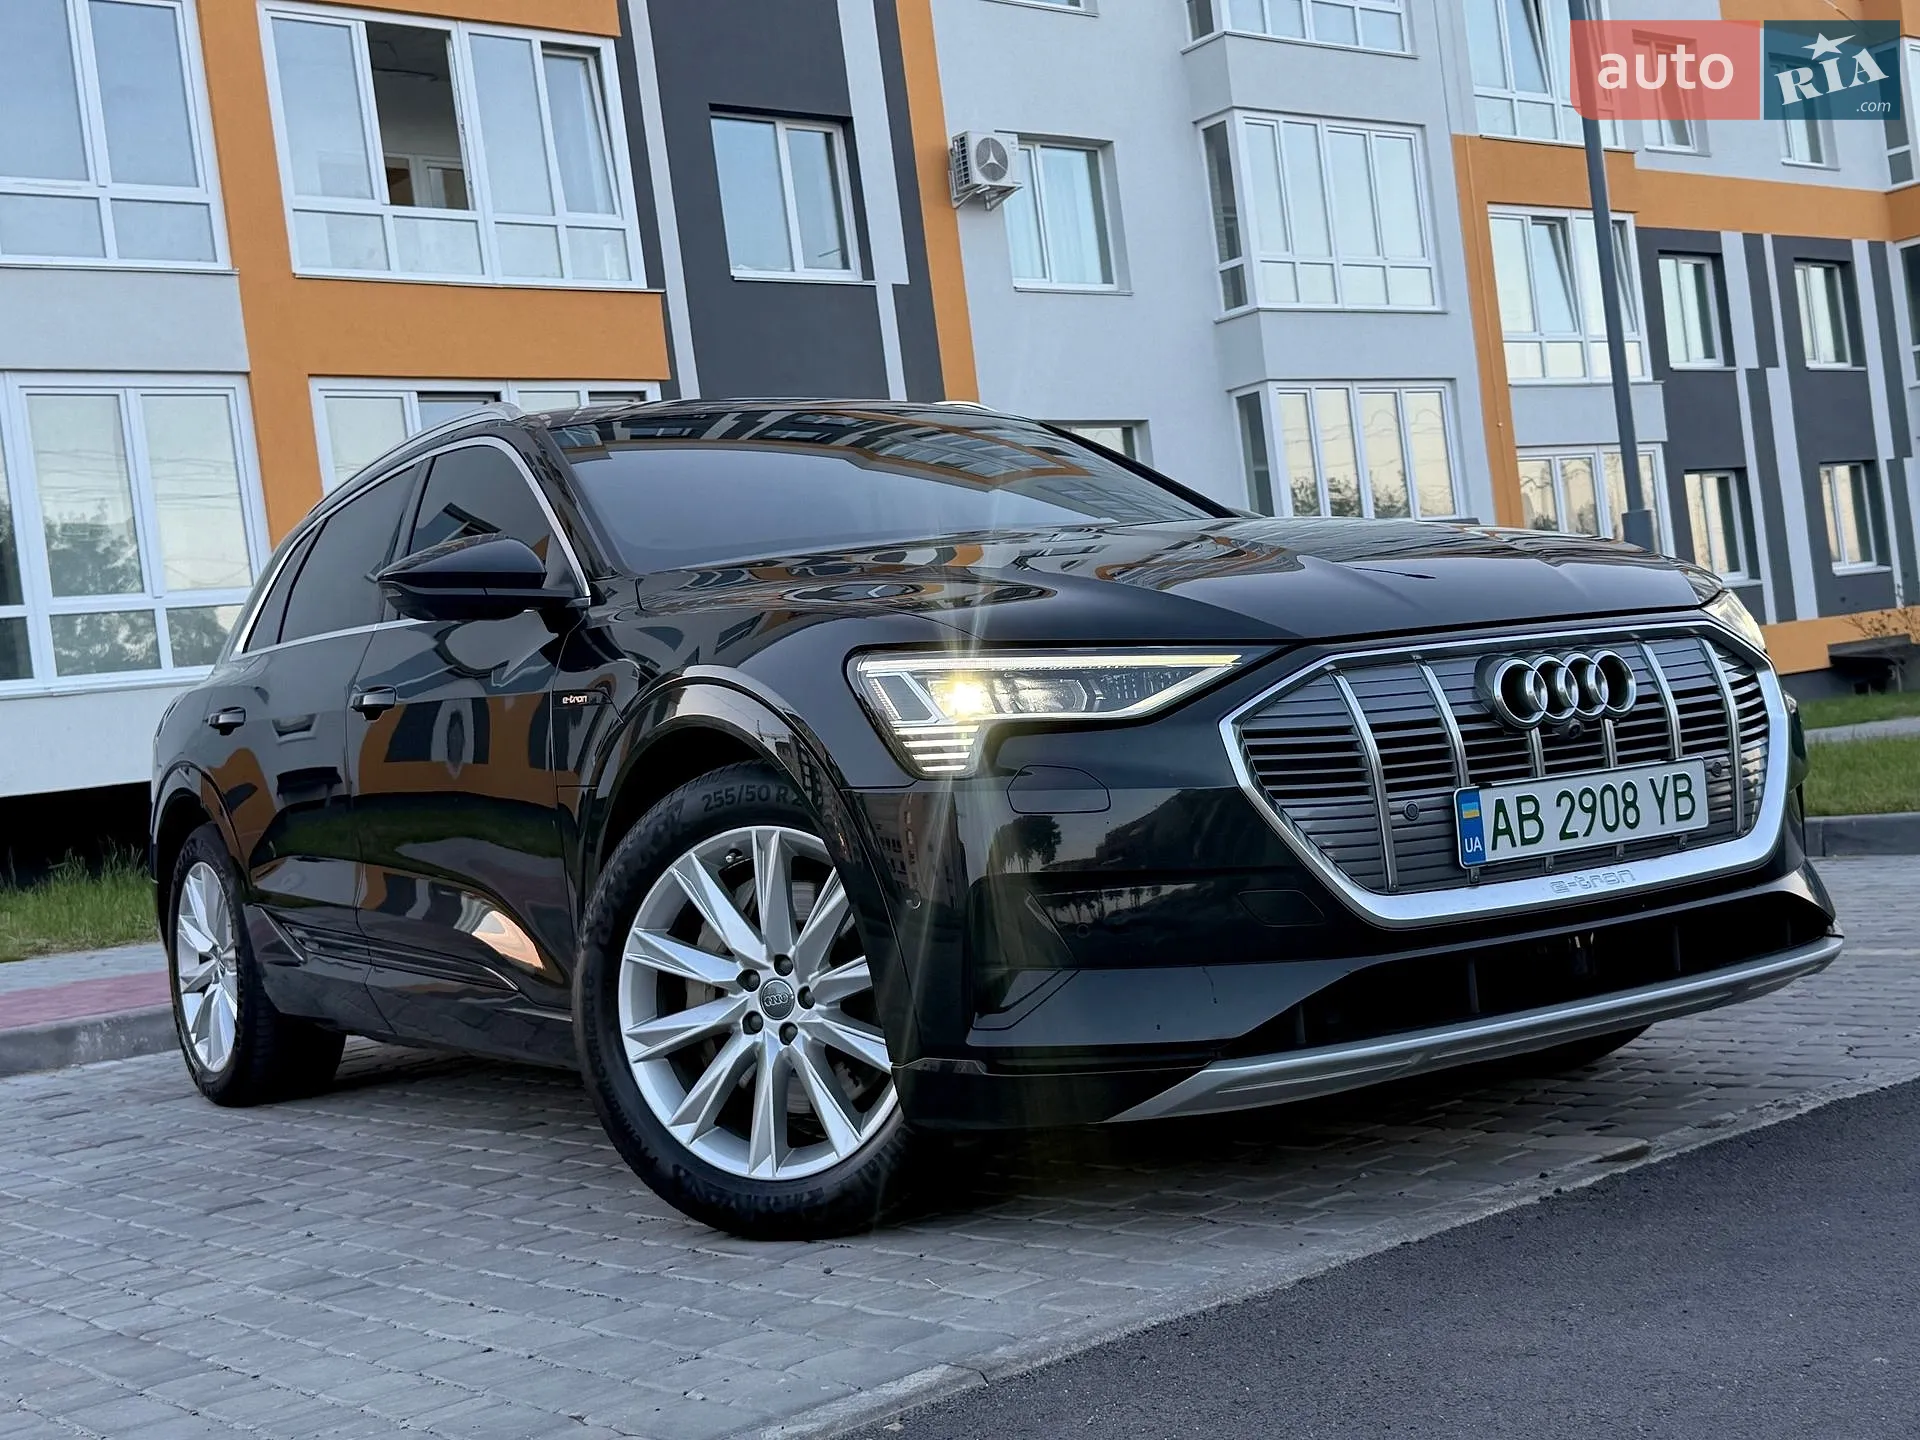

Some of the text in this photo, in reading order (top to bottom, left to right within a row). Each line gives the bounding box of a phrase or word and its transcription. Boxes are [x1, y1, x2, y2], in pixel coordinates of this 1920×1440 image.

[562, 695, 588, 704] e-tron
[702, 783, 771, 812] 255/50
[1491, 772, 1696, 851] AB 2908 YB
[1465, 837, 1483, 853] UA
[1550, 869, 1636, 894] e-tron
